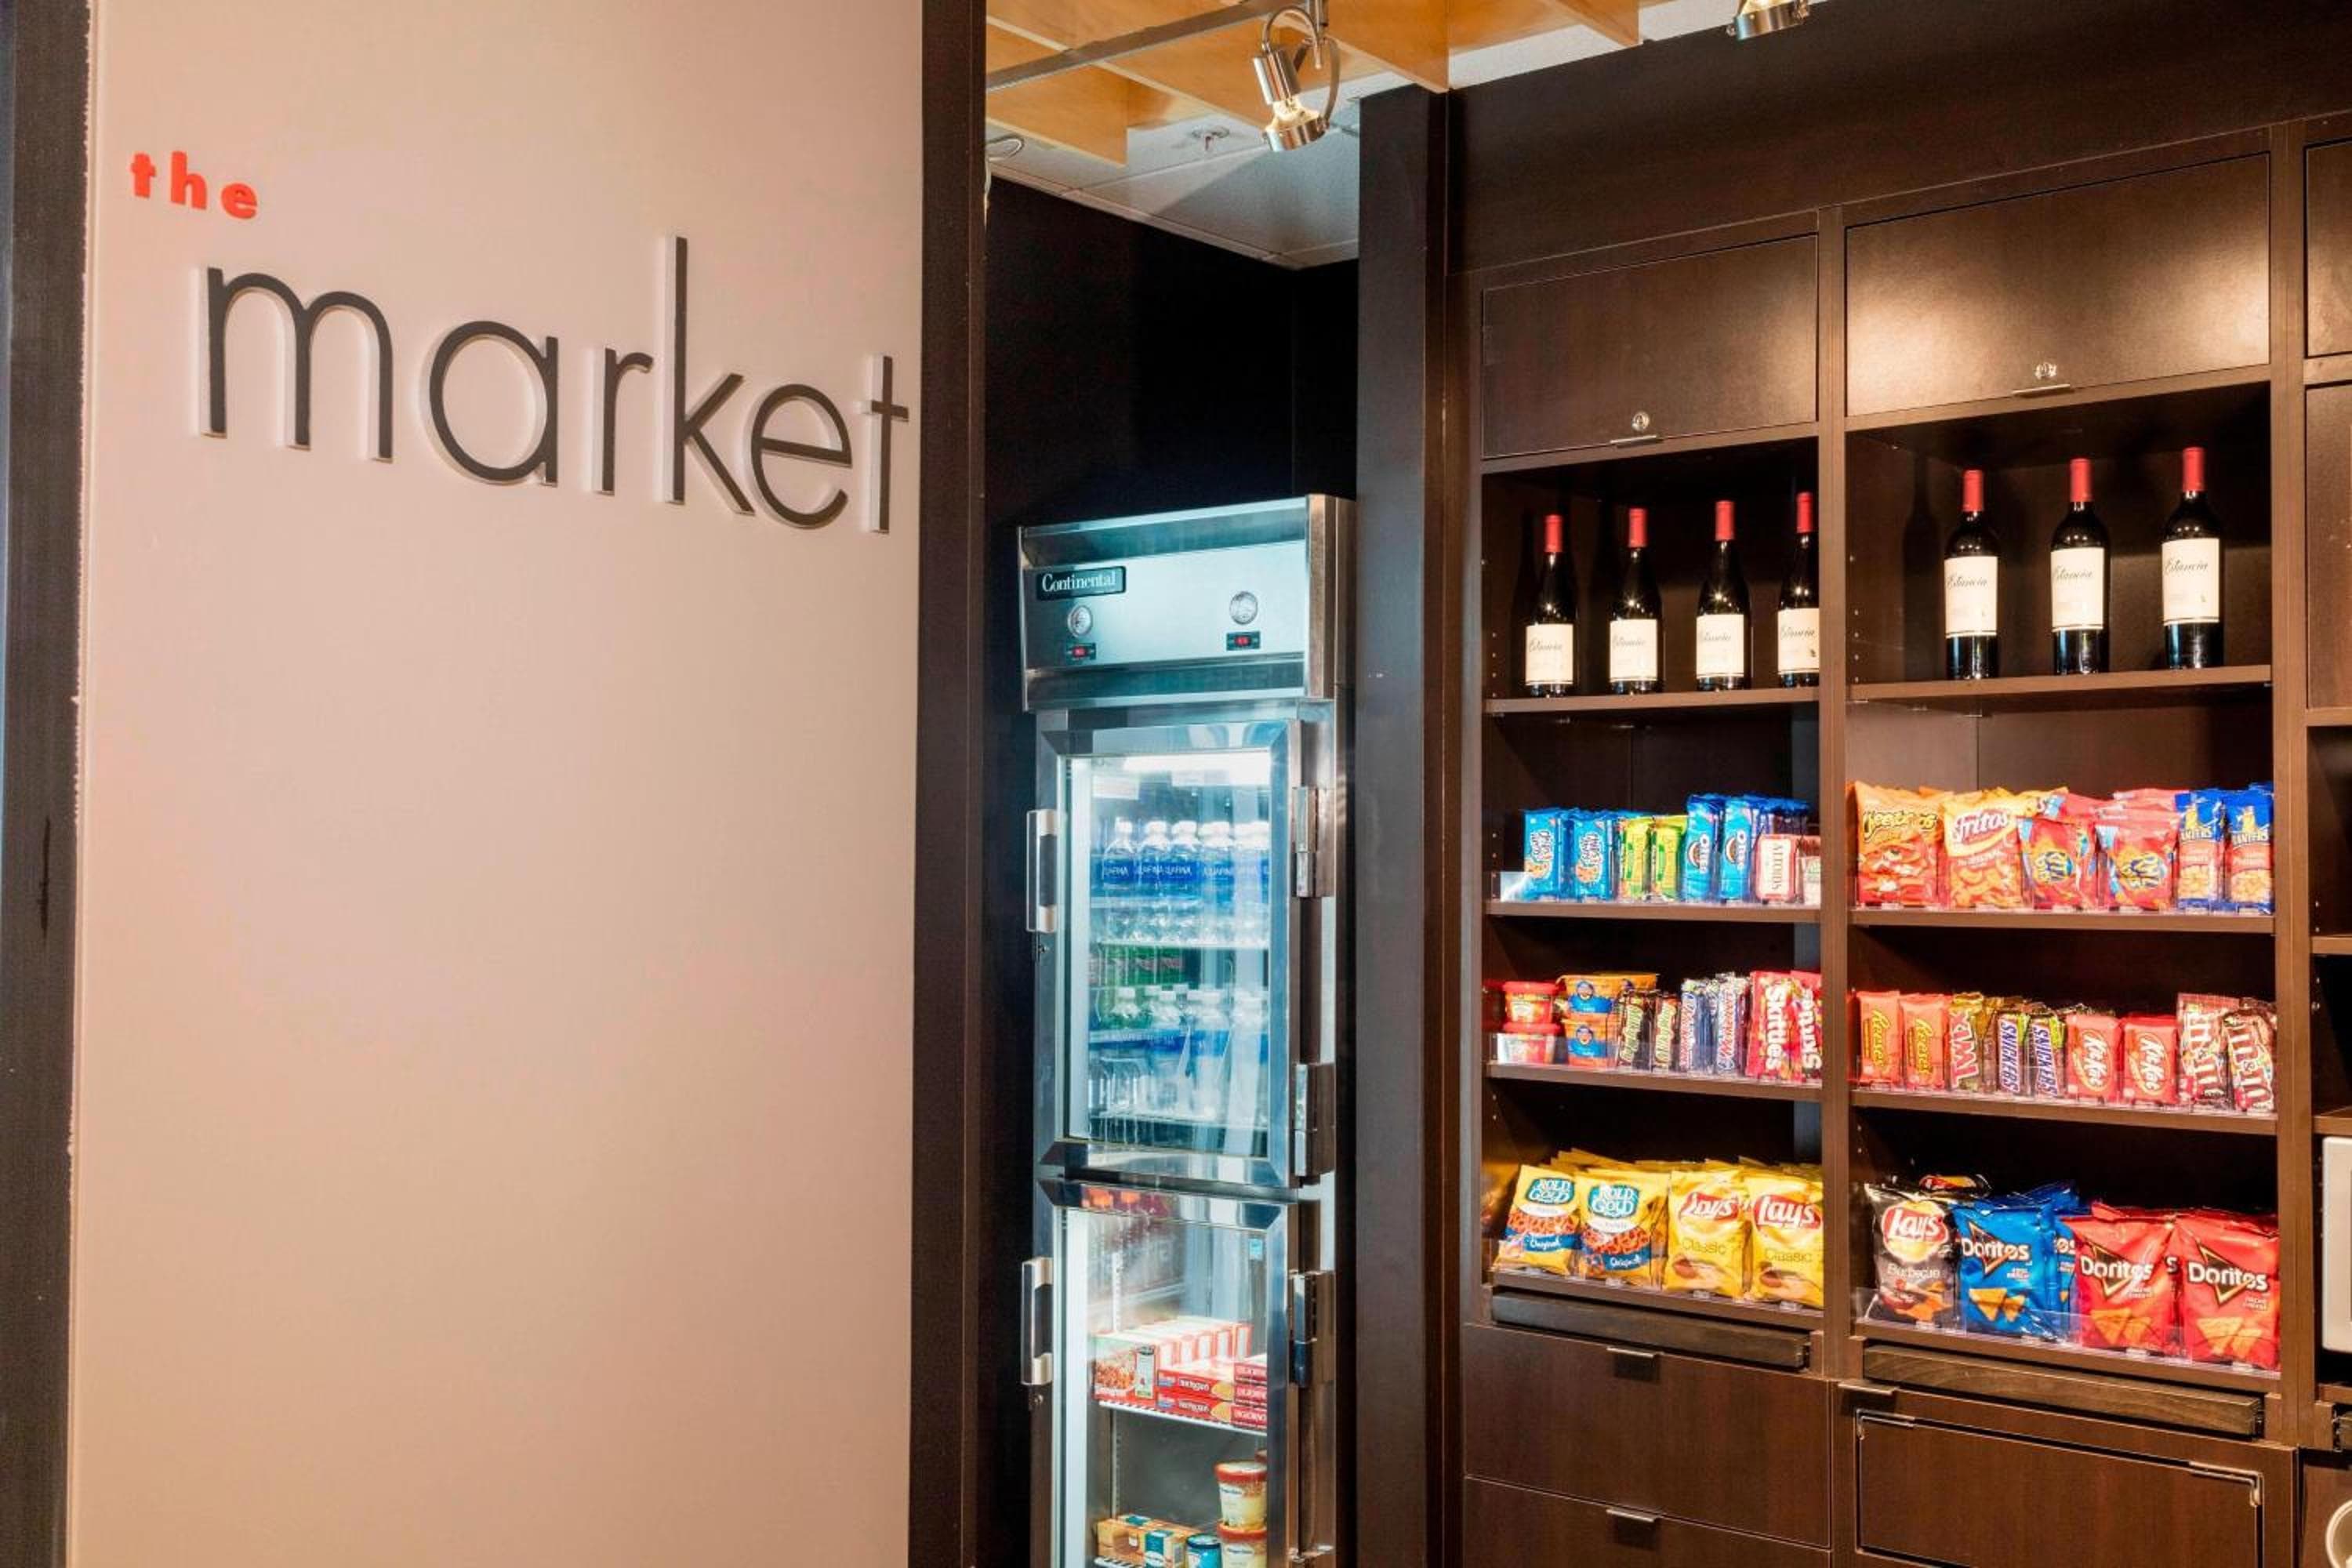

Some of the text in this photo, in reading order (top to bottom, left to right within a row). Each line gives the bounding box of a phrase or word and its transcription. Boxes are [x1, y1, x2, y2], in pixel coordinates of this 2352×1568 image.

[129, 151, 258, 220] the
[199, 235, 909, 534] market
[1041, 570, 1116, 592] Continental
[1952, 810, 2009, 844] Fritos
[2000, 1021, 2020, 1093] SNICKERS
[2034, 1026, 2058, 1096] SNICKERS
[1961, 1238, 2029, 1260] Doritos
[2080, 1256, 2153, 1280] Doritos
[2187, 1261, 2268, 1290] Doritos
